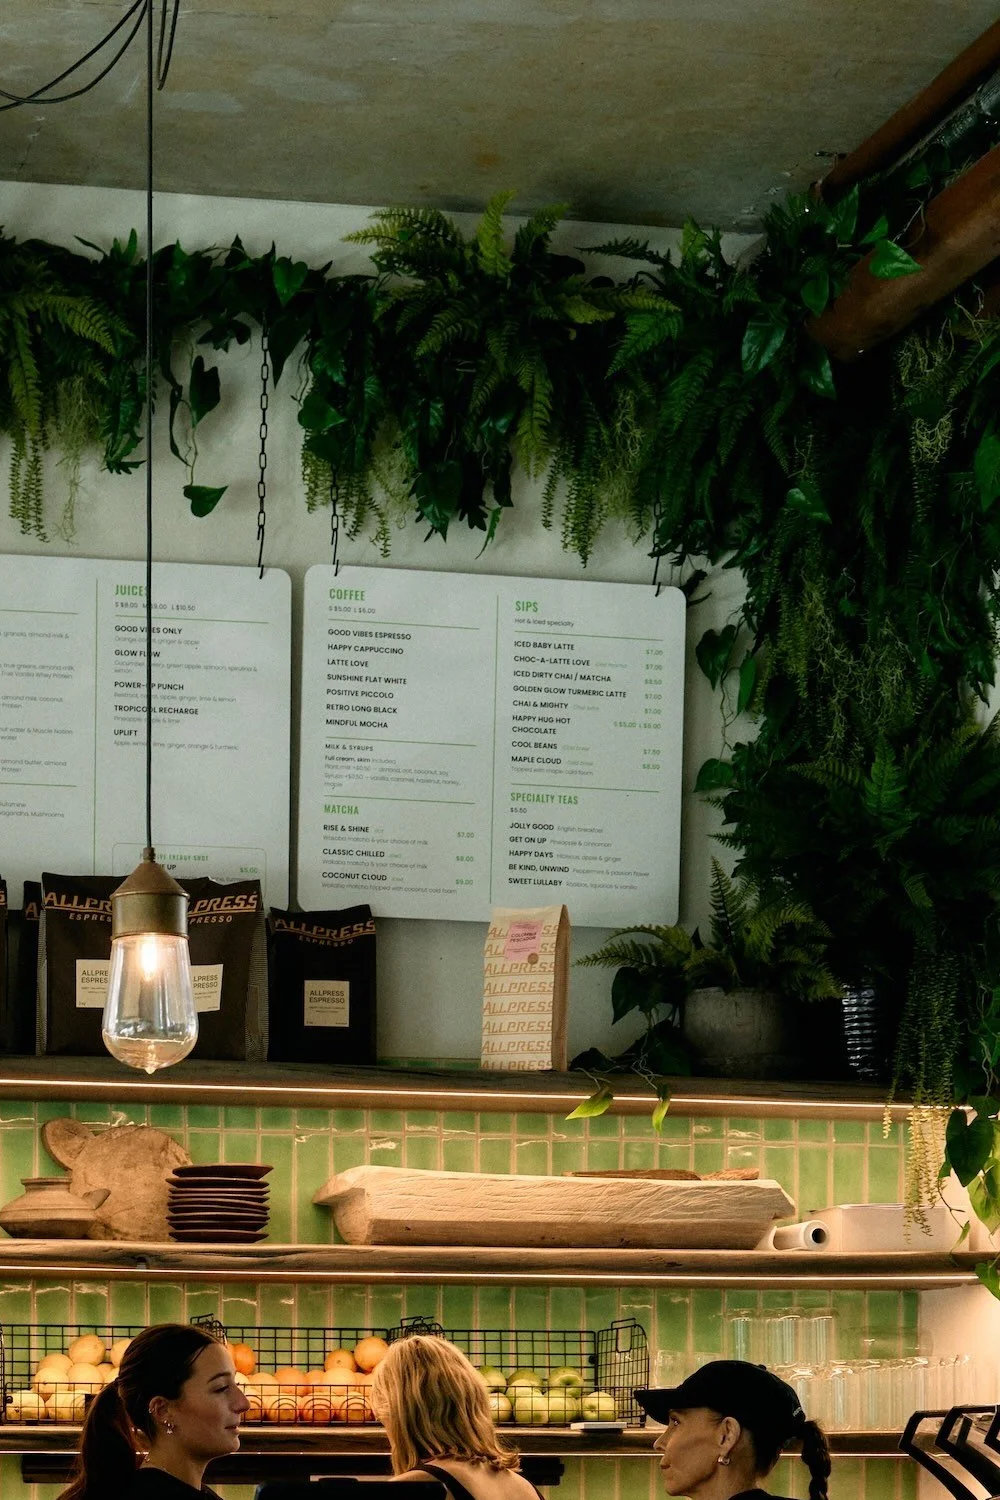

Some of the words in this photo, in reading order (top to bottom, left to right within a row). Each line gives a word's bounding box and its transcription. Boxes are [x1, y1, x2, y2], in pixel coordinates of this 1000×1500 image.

[115, 584, 147, 596] JUICE
[328, 588, 365, 601] COFFEE
[514, 600, 538, 613] SIPS
[327, 628, 351, 636] GOOD
[351, 630, 374, 638] VIBES
[374, 631, 412, 640] ESPRESSO
[327, 643, 352, 651] HAPPY
[353, 645, 404, 654] CAPPUCCINO
[513, 640, 532, 648] ICED
[552, 642, 574, 651] LATTE
[326, 658, 348, 666] LATTE
[349, 659, 368, 668] LOVE
[513, 655, 570, 665] CHOC-A-LATTE
[571, 658, 590, 666] LOVE
[326, 673, 363, 682] SUNSHINE
[383, 676, 407, 685] WHITE
[326, 688, 359, 697] POSITIVE
[360, 690, 394, 699] PICCOLO
[325, 703, 350, 711] RETRO
[350, 704, 372, 713] LONG
[372, 706, 398, 714] BLACK
[325, 718, 358, 726] MINDFUL
[358, 720, 388, 728] MOCHA
[511, 725, 556, 734] CHOCOLATE
[511, 740, 532, 748] COOL
[533, 741, 558, 750] BEANS
[510, 755, 534, 763] MAPLE
[535, 756, 562, 765] CLOUD
[510, 791, 555, 803] SPECIALTY
[557, 794, 578, 805] TEAS
[323, 804, 359, 814] MATCHA
[508, 821, 531, 829] JOLLY
[531, 822, 555, 831] GOOD
[322, 847, 354, 856] CLASSIC
[354, 849, 385, 858] CHILLED
[533, 850, 554, 858] DAYS
[321, 871, 360, 879] COCONUT
[360, 872, 387, 881] CLOUD
[507, 876, 532, 885] SWEET
[532, 878, 563, 886] LULLABY
[274, 918, 376, 936] ALLPRESS
[299, 935, 354, 947] ESPRESSO
